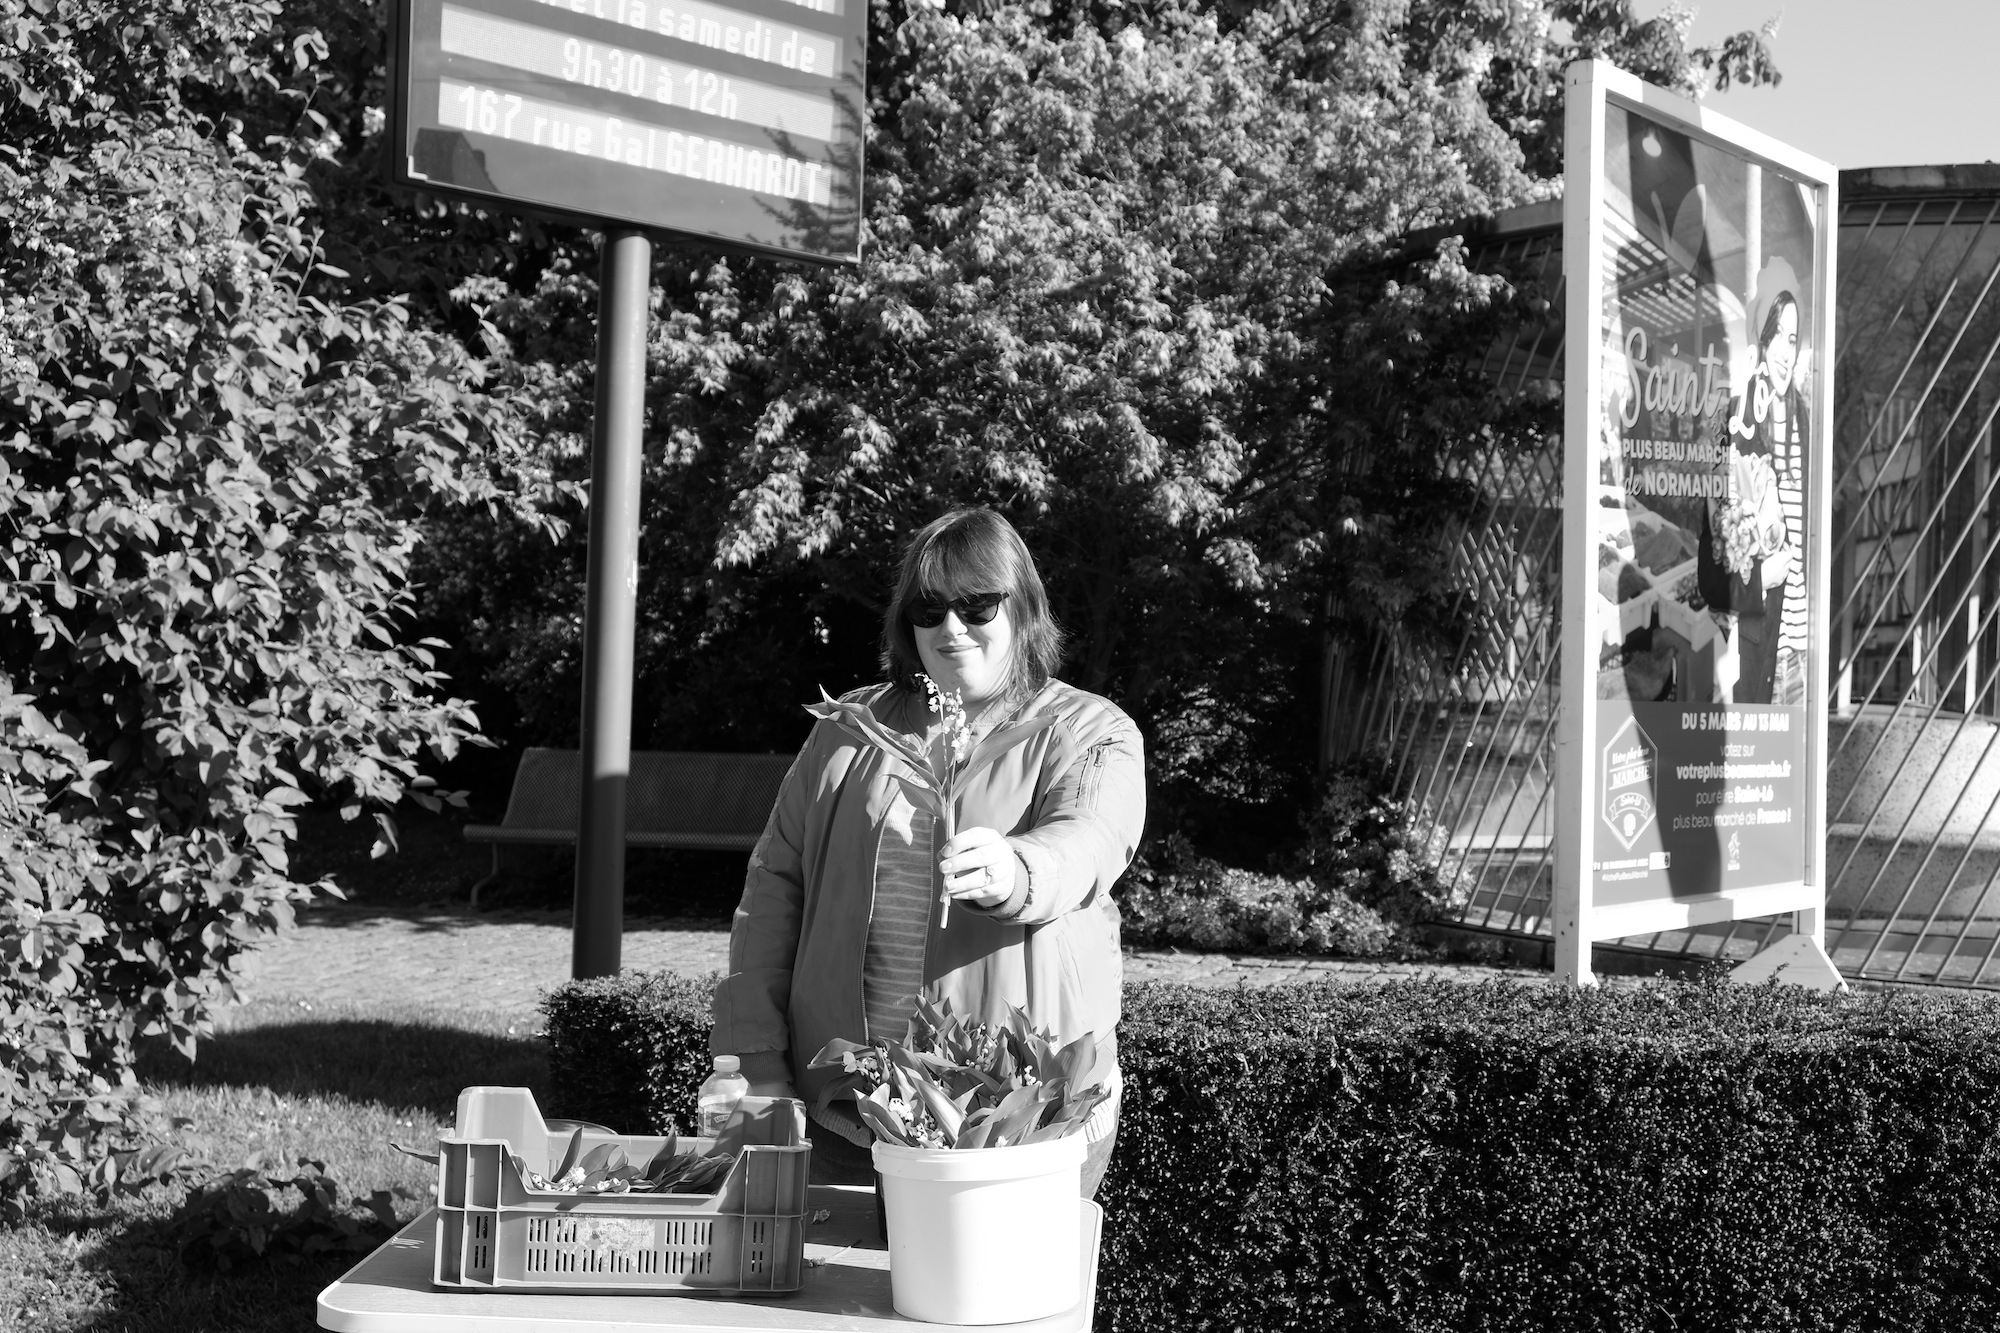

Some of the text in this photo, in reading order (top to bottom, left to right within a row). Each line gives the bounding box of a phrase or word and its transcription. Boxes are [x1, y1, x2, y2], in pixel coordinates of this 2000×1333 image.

[617, 0, 646, 29] la
[658, 7, 772, 62] samedi
[781, 31, 816, 74] de
[562, 37, 737, 120] 9h30 à 12h
[459, 86, 822, 203] 167 rue Gal GERHARDT
[1622, 438, 1653, 459] PLUS
[1654, 440, 1685, 461] BEAU
[1624, 466, 1738, 498] de NORMANDIE
[1682, 711, 1789, 732] DU 5 MARS AU 13 MAI
[1720, 743, 1756, 757] votez sur
[1676, 760, 1792, 783] votreplusbeaumarche.fr
[1696, 792, 1716, 807] pour
[1734, 784, 1774, 803] Saint-Lô
[1673, 815, 1691, 832] plus
[1691, 814, 1713, 828] beau
[1714, 811, 1745, 827] marché
[1745, 811, 1756, 825] de
[1757, 807, 1787, 824] France
